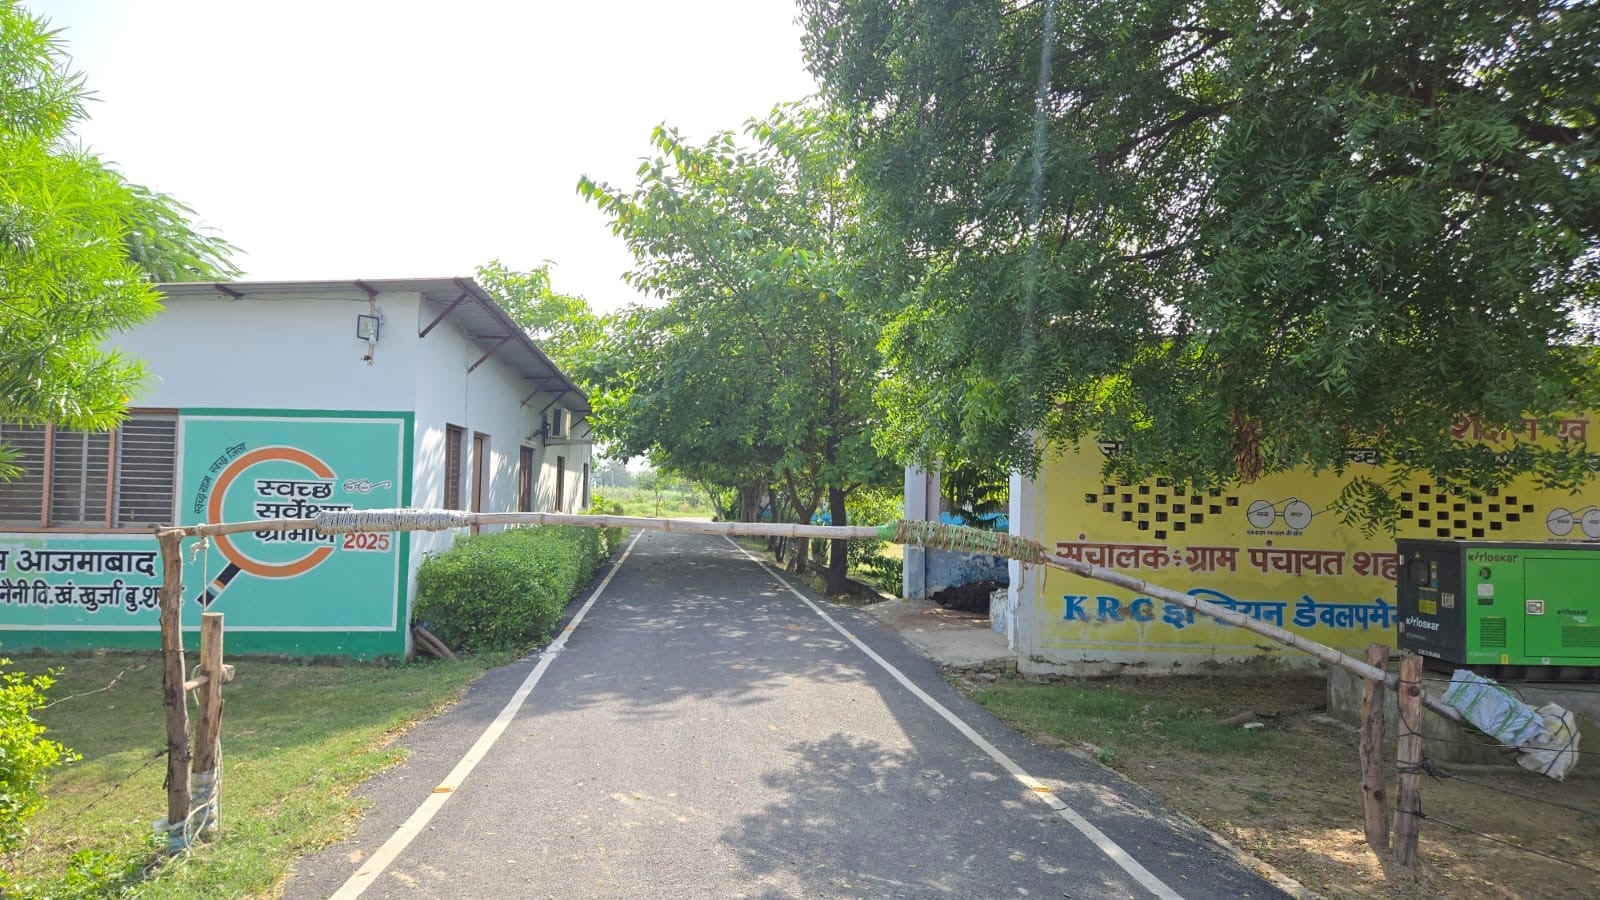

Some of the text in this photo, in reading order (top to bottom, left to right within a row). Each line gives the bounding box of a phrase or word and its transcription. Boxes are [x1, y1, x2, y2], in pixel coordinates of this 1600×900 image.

[256, 480, 333, 499] स्वच्छ
[343, 533, 390, 550] 2025
[16, 550, 157, 577] आजमाबाद
[1185, 546, 1240, 572] ग्राम
[1247, 539, 1346, 577] पंचायत
